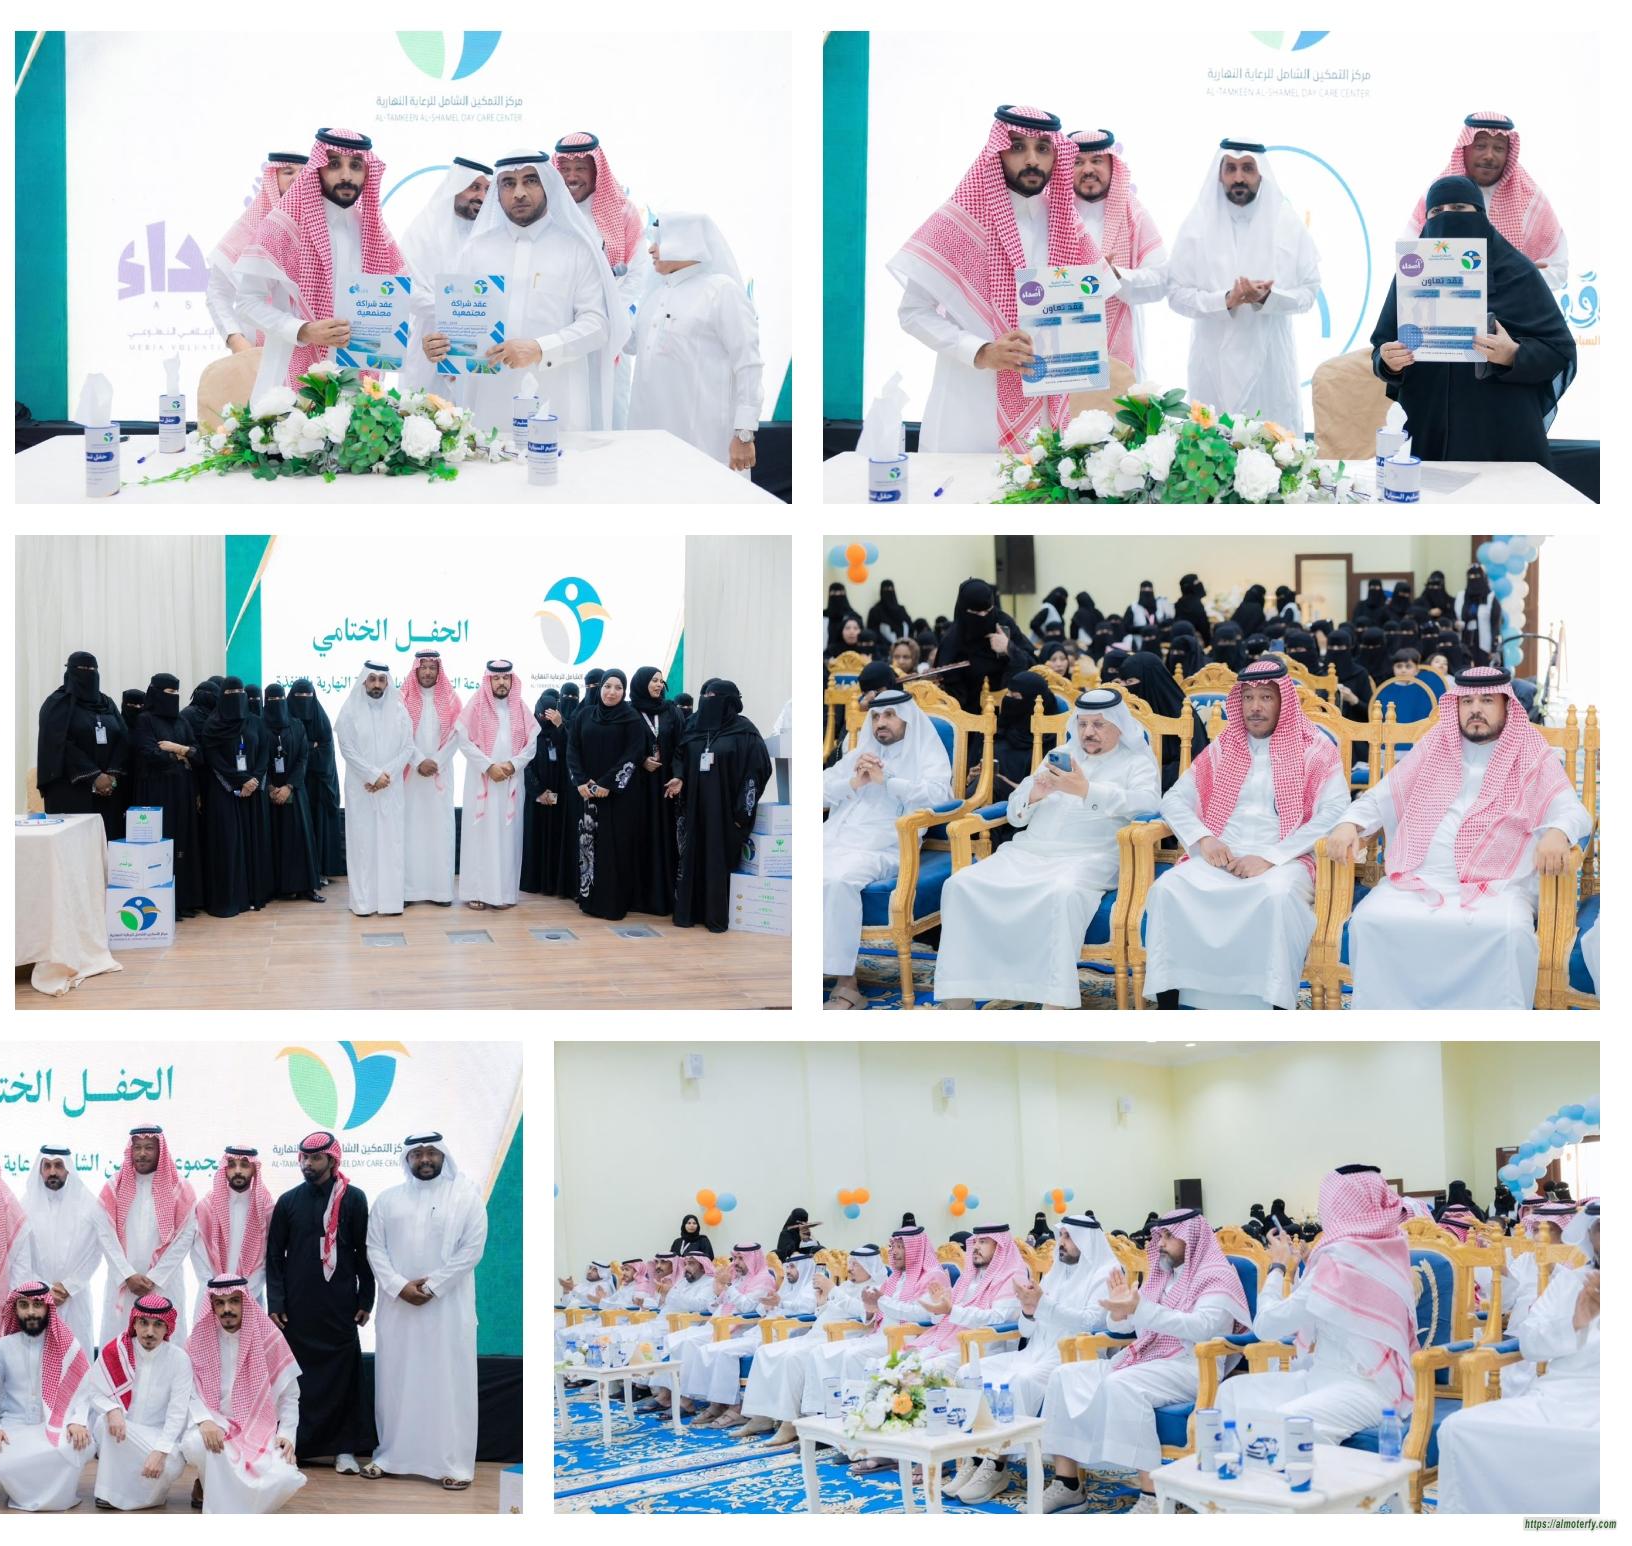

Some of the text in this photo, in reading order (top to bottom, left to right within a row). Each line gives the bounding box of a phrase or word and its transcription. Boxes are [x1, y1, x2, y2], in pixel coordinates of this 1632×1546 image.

[1207, 68, 1371, 82] مركز التمكين الشامل للرعاية النهارية
[376, 95, 523, 108] مركز التمكين الشامل للرعاية النهارية
[118, 220, 211, 300] داء
[356, 300, 377, 308] شراكة
[451, 300, 471, 309] شراكة
[313, 617, 469, 658] الحفل الختامي
[317, 676, 351, 694] النهارية
[62, 1064, 174, 1118] الحفل
[342, 1143, 359, 1153] الشا
[361, 1143, 392, 1155] التمكين
[393, 1143, 403, 1155] كز
[4, 1154, 31, 1176] عاية
[75, 1153, 99, 1172] الشا
[175, 1157, 219, 1178] جموع
[384, 1160, 401, 1168] CENT
